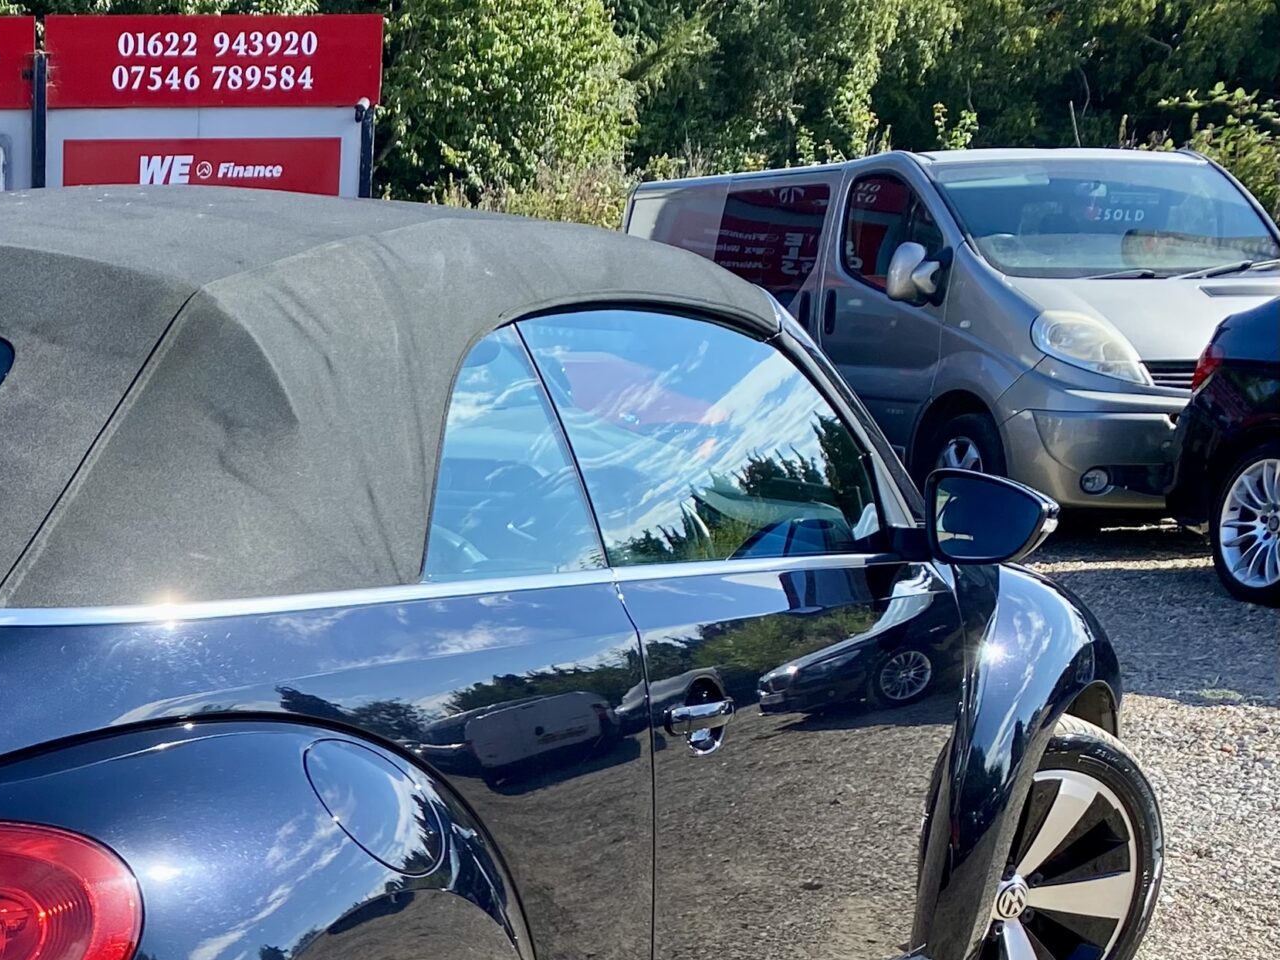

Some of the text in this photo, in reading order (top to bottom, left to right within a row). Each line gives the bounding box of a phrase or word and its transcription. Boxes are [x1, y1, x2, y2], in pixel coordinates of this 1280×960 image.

[117, 31, 318, 57] 01622 943920
[112, 65, 314, 91] 07546 789584
[140, 155, 194, 185] WE
[217, 162, 283, 178] Finance
